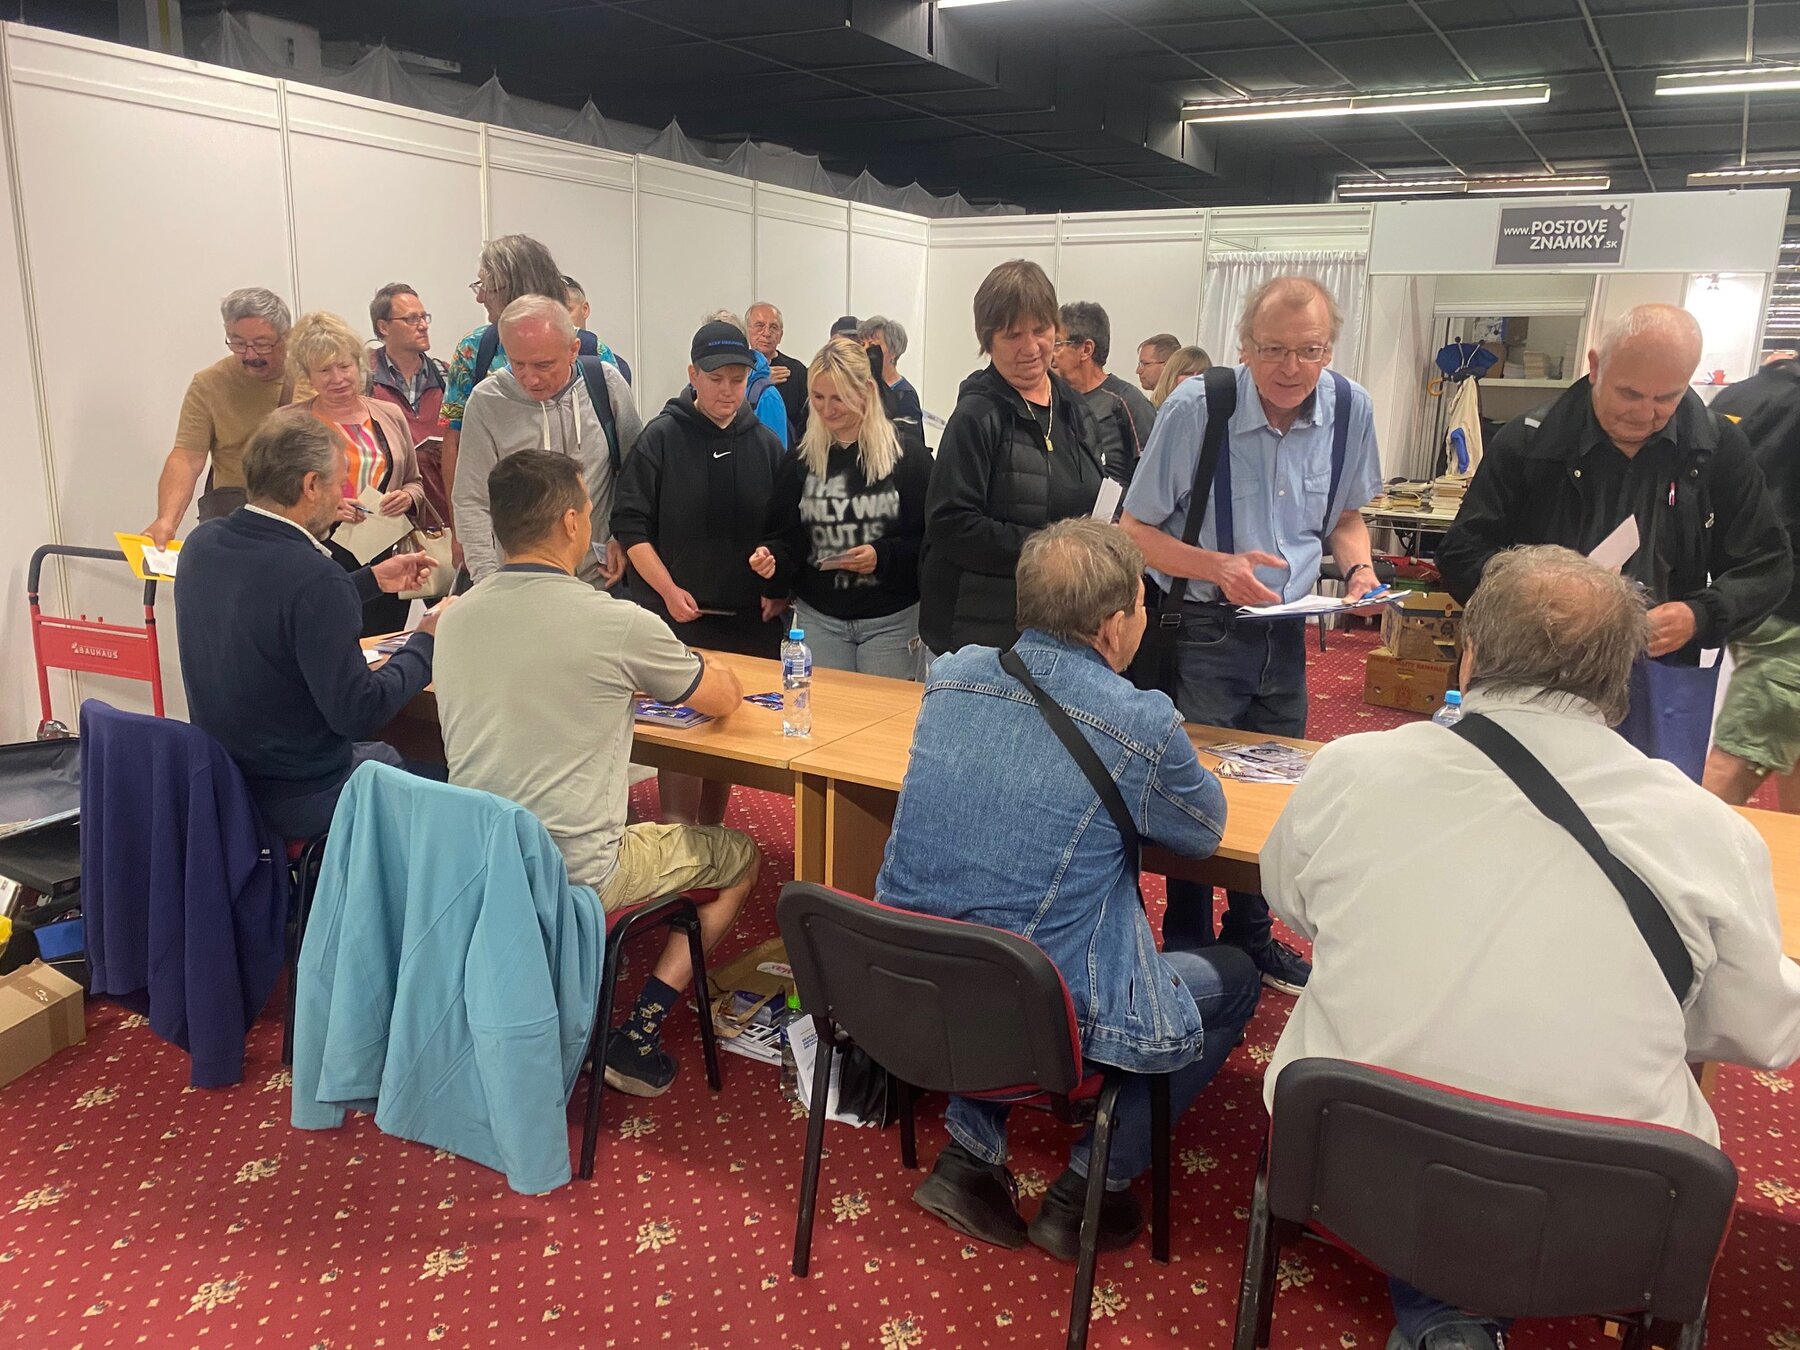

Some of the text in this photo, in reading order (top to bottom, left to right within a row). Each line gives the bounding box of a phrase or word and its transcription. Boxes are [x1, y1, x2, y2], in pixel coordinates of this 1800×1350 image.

[1503, 219, 1608, 235] www.POSTOVE
[812, 523, 858, 547] OUT
[79, 646, 118, 658] BAUHAUS
